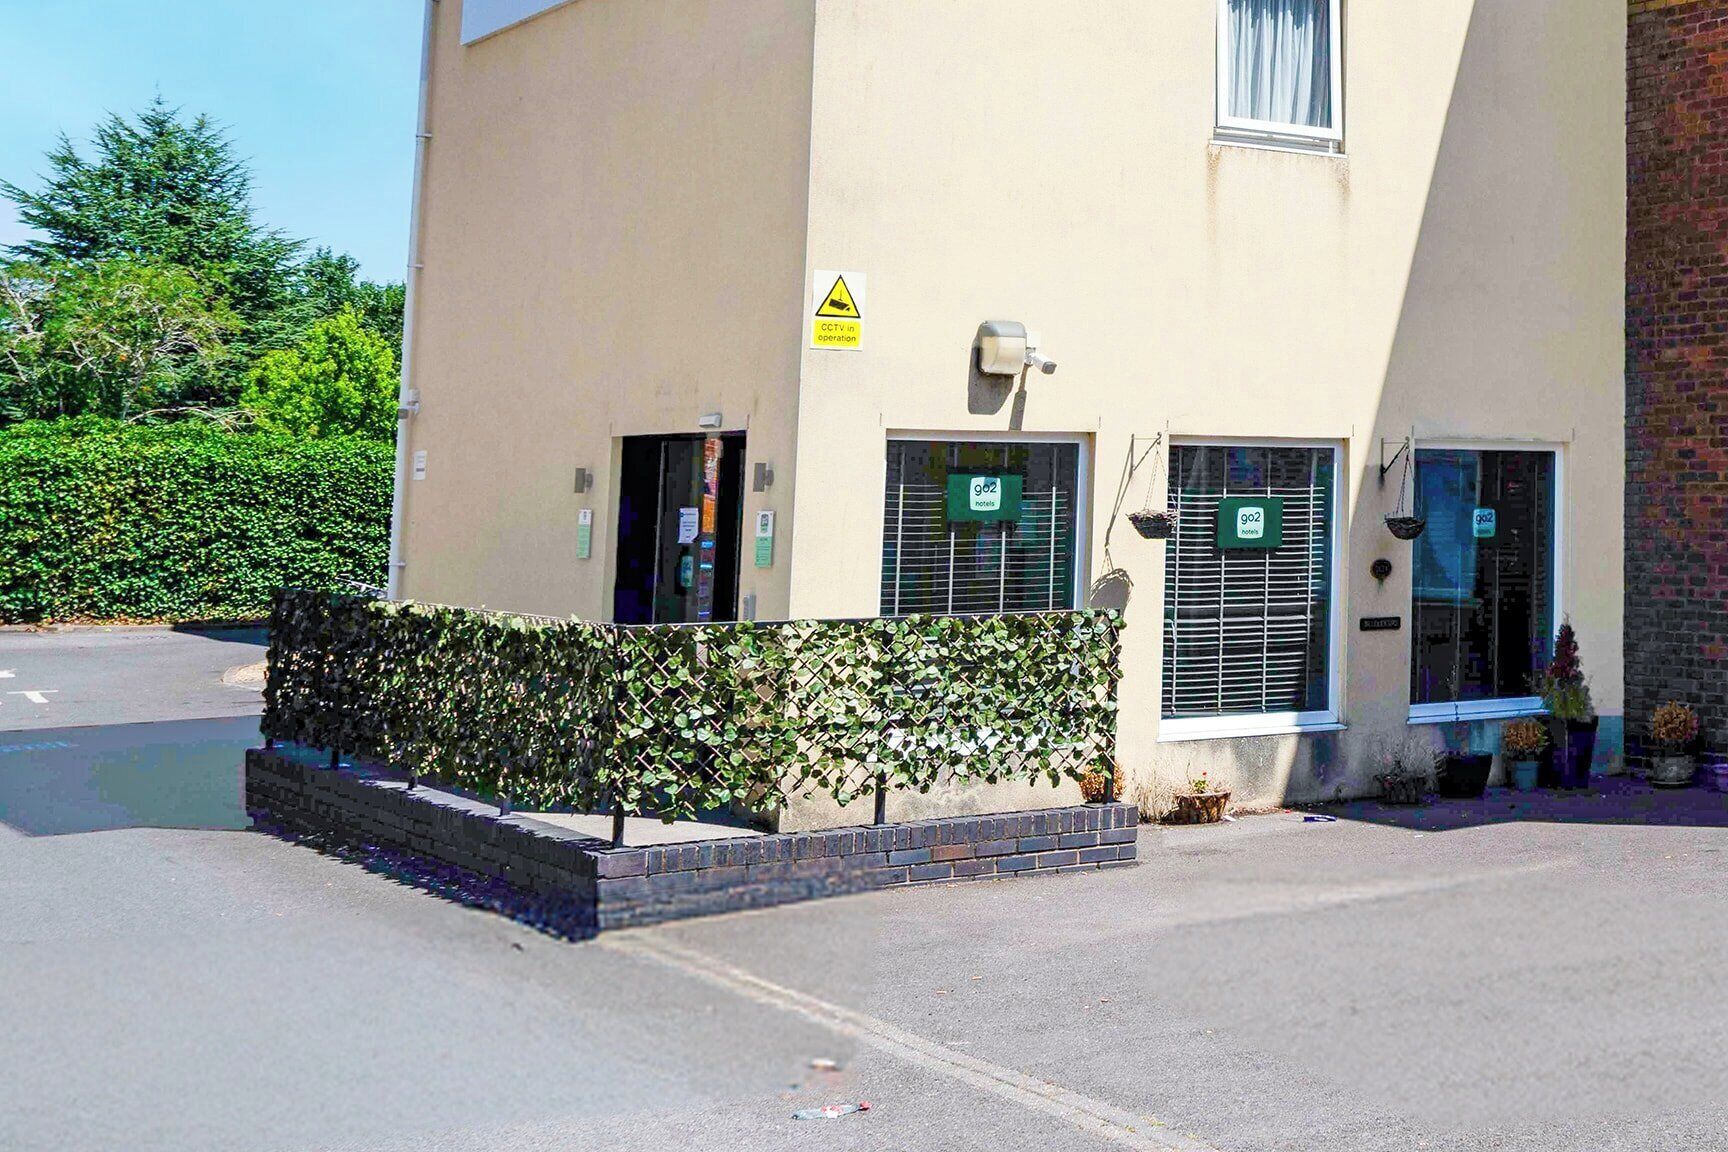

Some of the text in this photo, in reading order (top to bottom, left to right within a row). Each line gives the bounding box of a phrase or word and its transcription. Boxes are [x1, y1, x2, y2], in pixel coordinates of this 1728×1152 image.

[821, 323, 855, 333] CCTV in
[818, 335, 856, 343] operation
[974, 481, 997, 496] go2
[1240, 511, 1261, 525] go2
